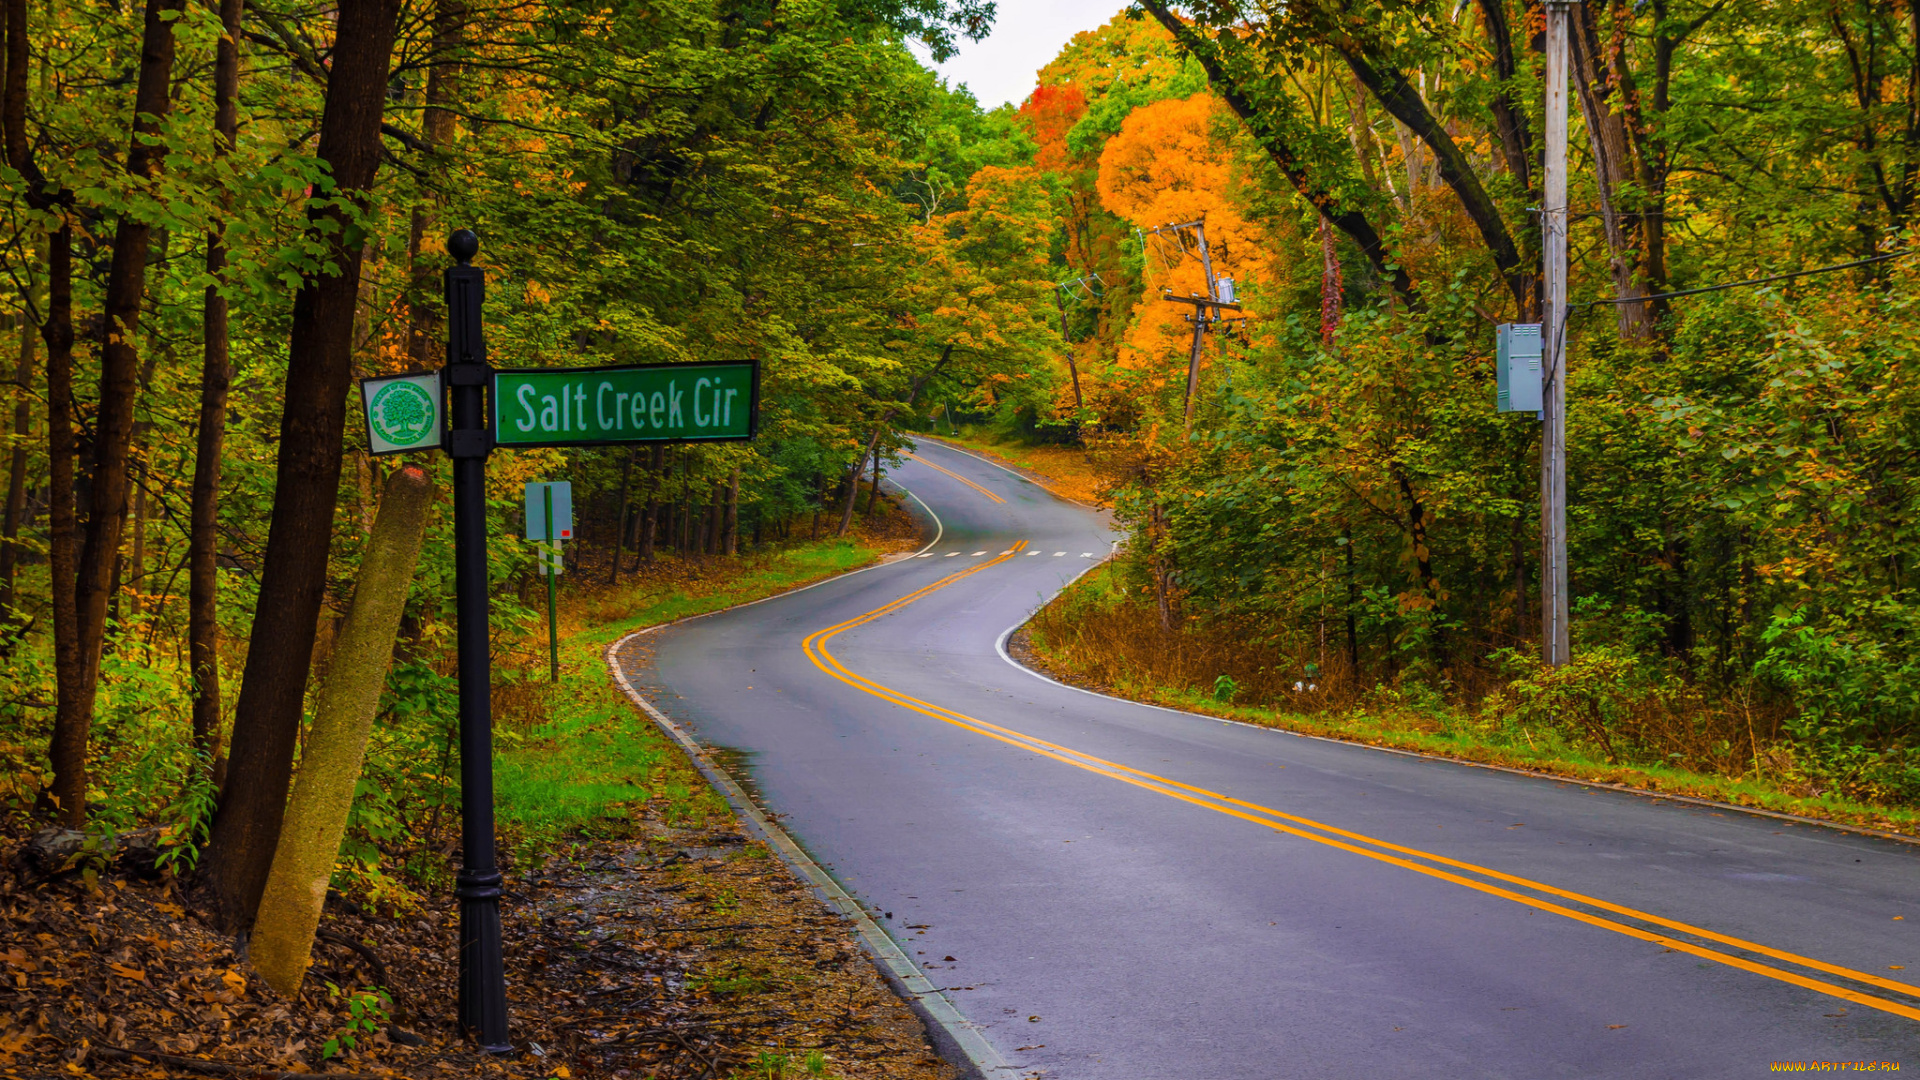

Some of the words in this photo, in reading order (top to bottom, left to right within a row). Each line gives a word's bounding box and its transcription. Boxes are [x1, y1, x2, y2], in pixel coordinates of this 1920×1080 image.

[516, 383, 587, 432] Salt
[597, 377, 684, 430] Creek
[694, 377, 738, 427] Cir
